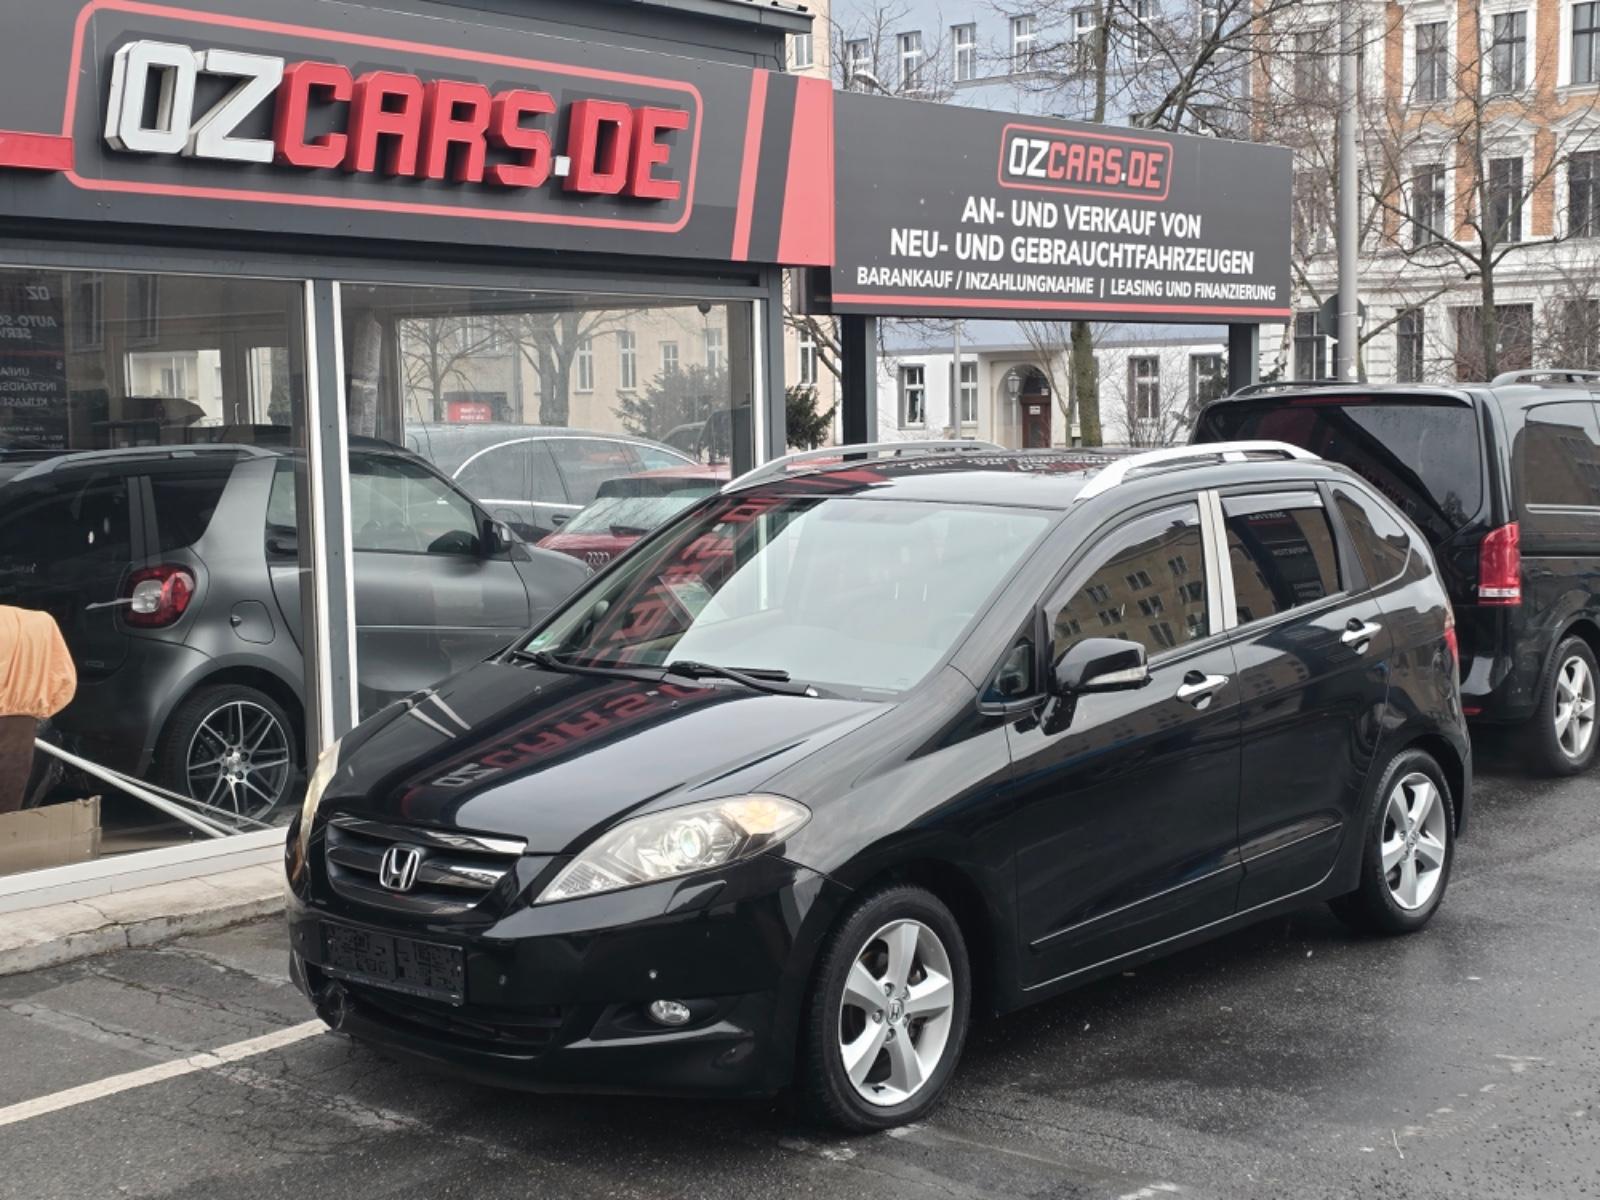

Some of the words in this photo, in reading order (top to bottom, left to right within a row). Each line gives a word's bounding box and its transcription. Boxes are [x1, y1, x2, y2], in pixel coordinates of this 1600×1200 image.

[105, 40, 689, 200] OZCARS.DE
[1009, 137, 1164, 189] OZCARS.DE
[961, 196, 1004, 224] AN-
[1012, 200, 1058, 228] UND
[1064, 204, 1157, 236] VERKAUF
[1161, 212, 1201, 239] VON
[890, 228, 948, 258] NEU-
[955, 232, 1004, 262] UND
[1011, 236, 1254, 275] GEBRAUCHTFAHRZEUGEN
[857, 266, 953, 289] BARANKAUF
[965, 271, 1094, 294] INZAHLUNGNAHME
[1111, 278, 1162, 297] LEASING
[1166, 281, 1191, 298] UND
[1194, 282, 1276, 301] FINANZIERUNG
